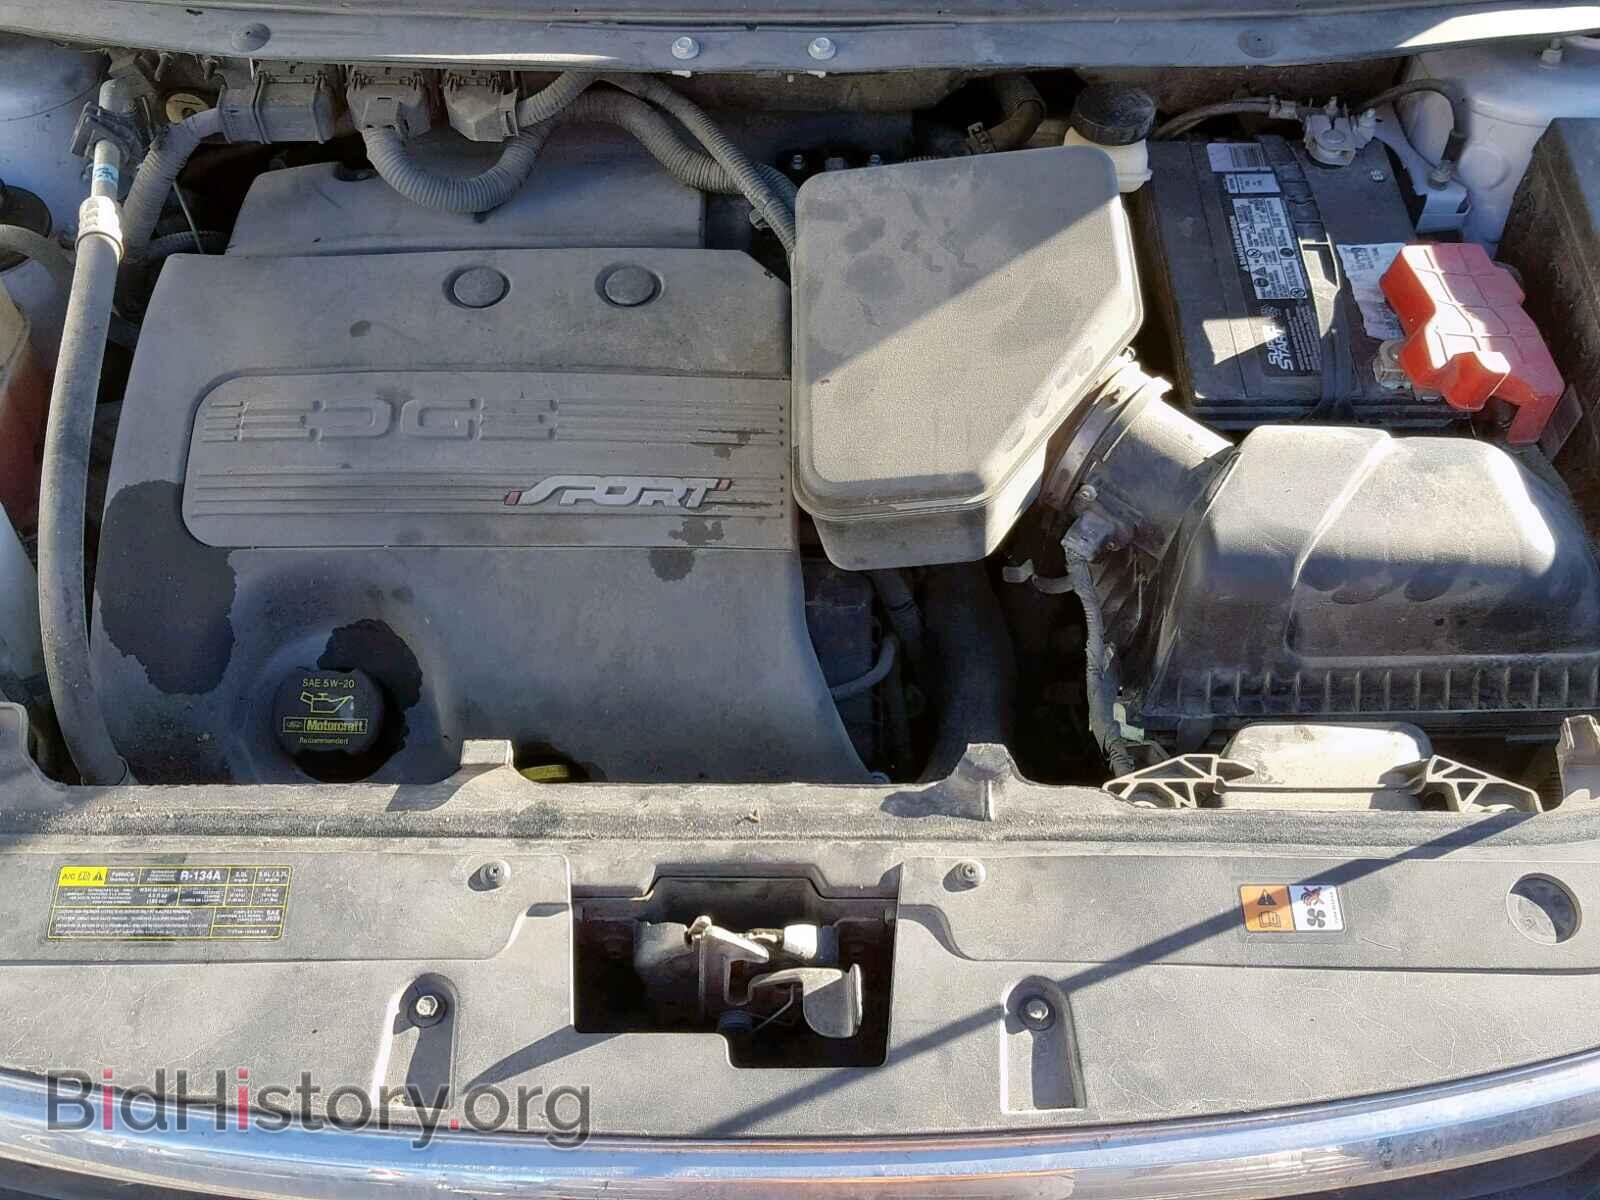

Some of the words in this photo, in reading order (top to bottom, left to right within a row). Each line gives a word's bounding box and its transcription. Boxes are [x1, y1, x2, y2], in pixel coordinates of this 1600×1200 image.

[234, 399, 559, 442] EDGE
[517, 475, 720, 509] SPORT
[302, 678, 321, 688] SAE
[323, 679, 355, 688] 5W-20
[306, 719, 364, 732] Motorcraft
[180, 870, 222, 880] R-134A
